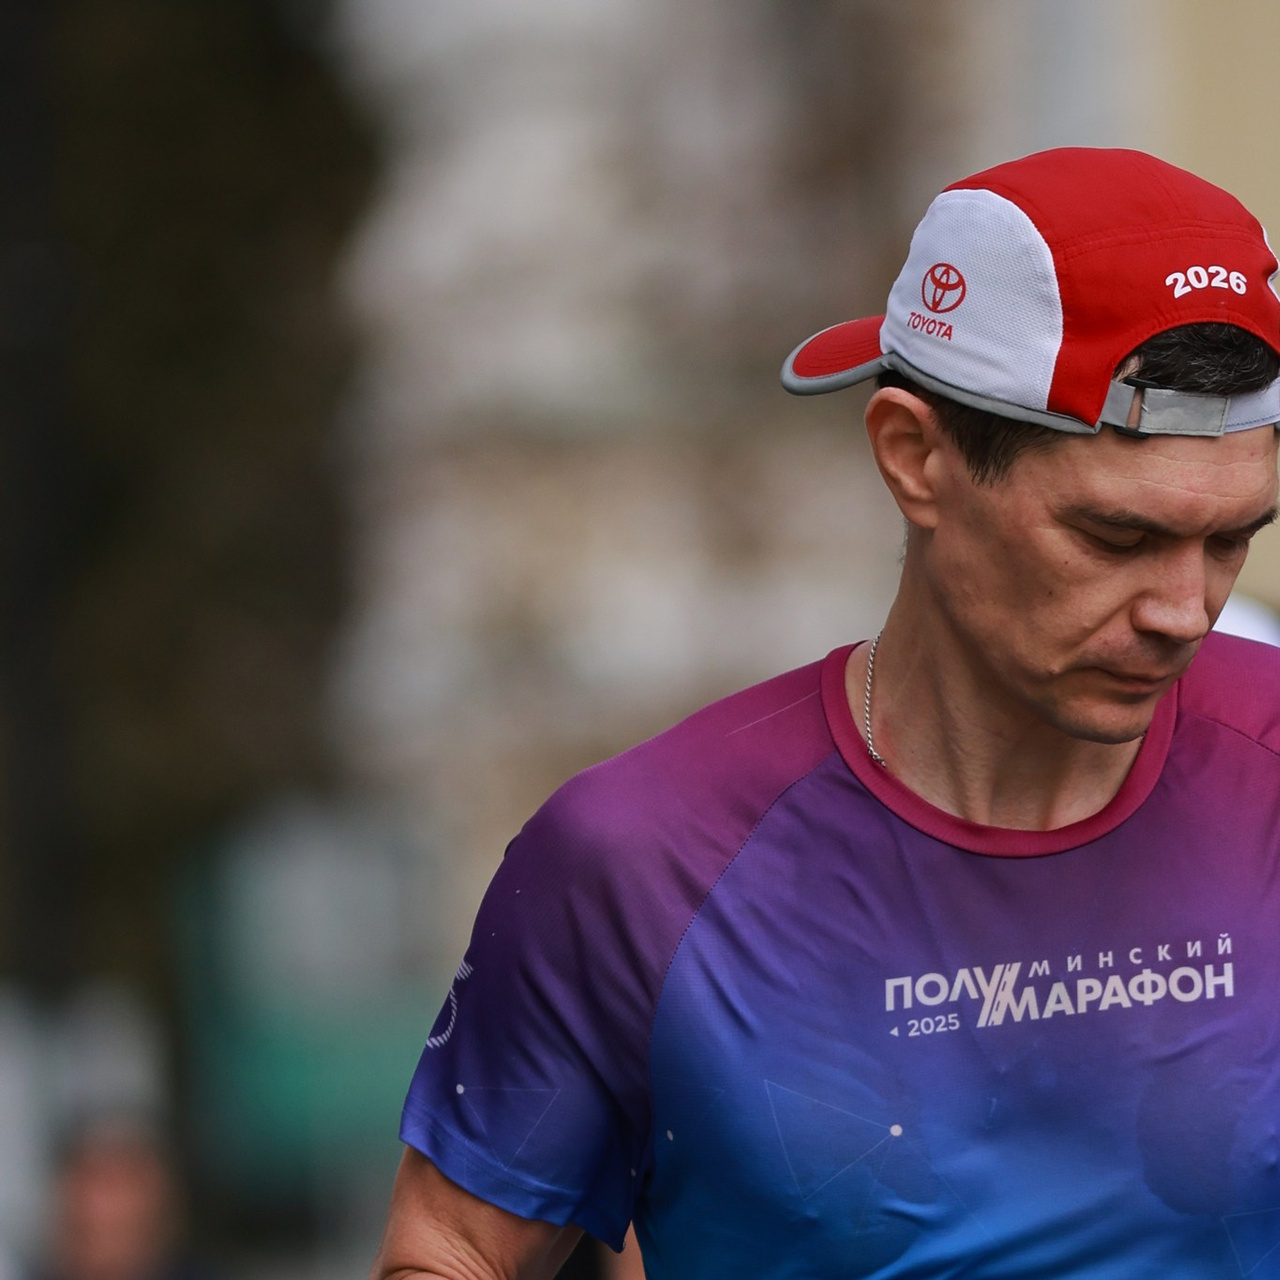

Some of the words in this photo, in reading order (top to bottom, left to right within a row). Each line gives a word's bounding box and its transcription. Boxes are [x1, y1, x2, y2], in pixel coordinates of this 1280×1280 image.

[1165, 265, 1247, 299] 2026
[907, 311, 953, 341] TOYOTA
[1028, 932, 1233, 978] МИНСКИЙ
[907, 1013, 960, 1037] 2025
